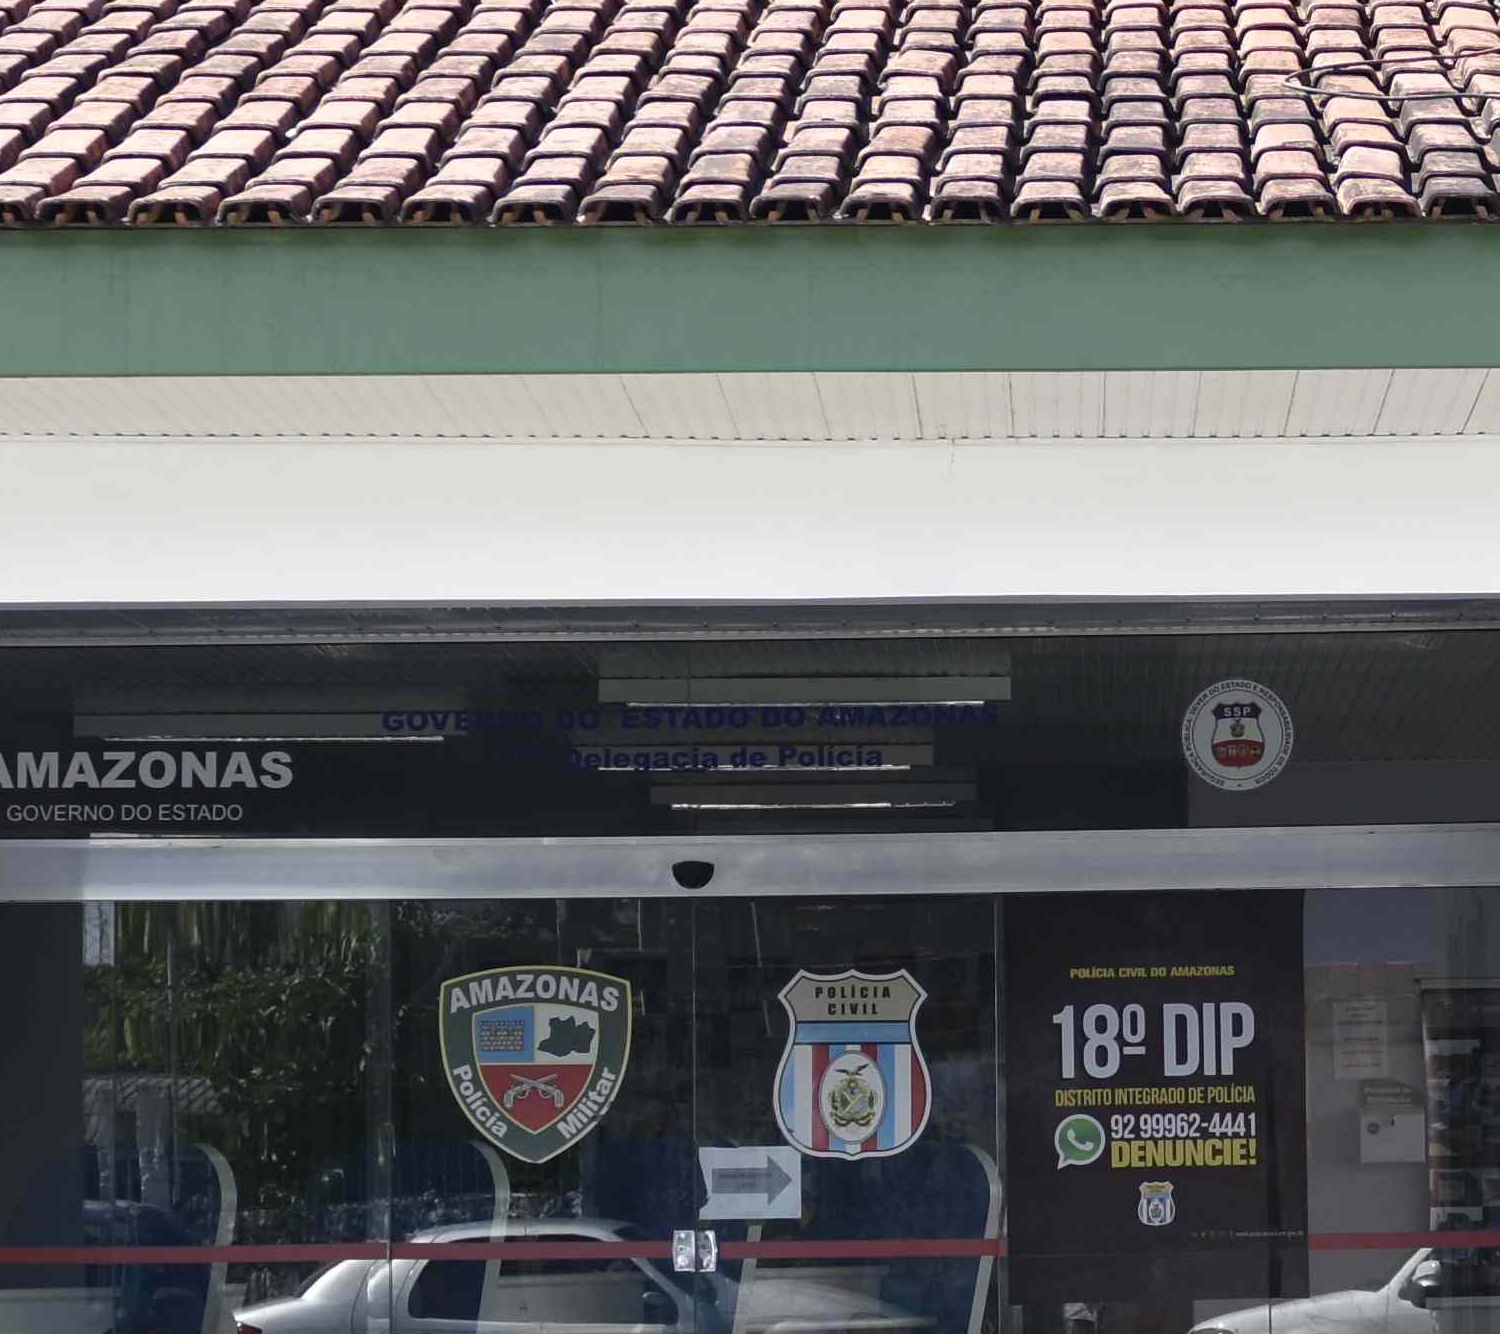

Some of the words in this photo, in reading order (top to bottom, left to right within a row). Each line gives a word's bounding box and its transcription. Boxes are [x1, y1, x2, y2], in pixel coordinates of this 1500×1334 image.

[381, 709, 548, 732] GOVE
[621, 706, 749, 729] ESTADO
[762, 705, 805, 728] DO
[1223, 706, 1251, 717] SSP
[730, 746, 767, 766] de
[6, 804, 114, 822] GOVERNO
[121, 804, 152, 821] DO
[158, 804, 243, 821] ESTADO
[1070, 966, 1115, 979] POLÍCIA
[1118, 966, 1148, 978] CIVIL
[1150, 966, 1166, 978] DO
[1170, 965, 1236, 977] AMAZONAS
[450, 974, 620, 1014] AMAZONAS
[814, 984, 891, 999] POLÍCIA
[827, 1002, 879, 1016] CIVIL
[1052, 1003, 1146, 1079] 18º
[1163, 1002, 1255, 1077] DIP
[556, 1067, 617, 1140] Militar
[1055, 1088, 1112, 1107] DISTRITO
[1115, 1087, 1185, 1105] INTEGRADO
[1188, 1086, 1204, 1104] DE
[1207, 1083, 1256, 1104] POLÍCIA
[1110, 1114, 1136, 1139] 92
[1139, 1112, 1256, 1138] 99962-4441
[1111, 1138, 1257, 1168] DENUNCIE!
